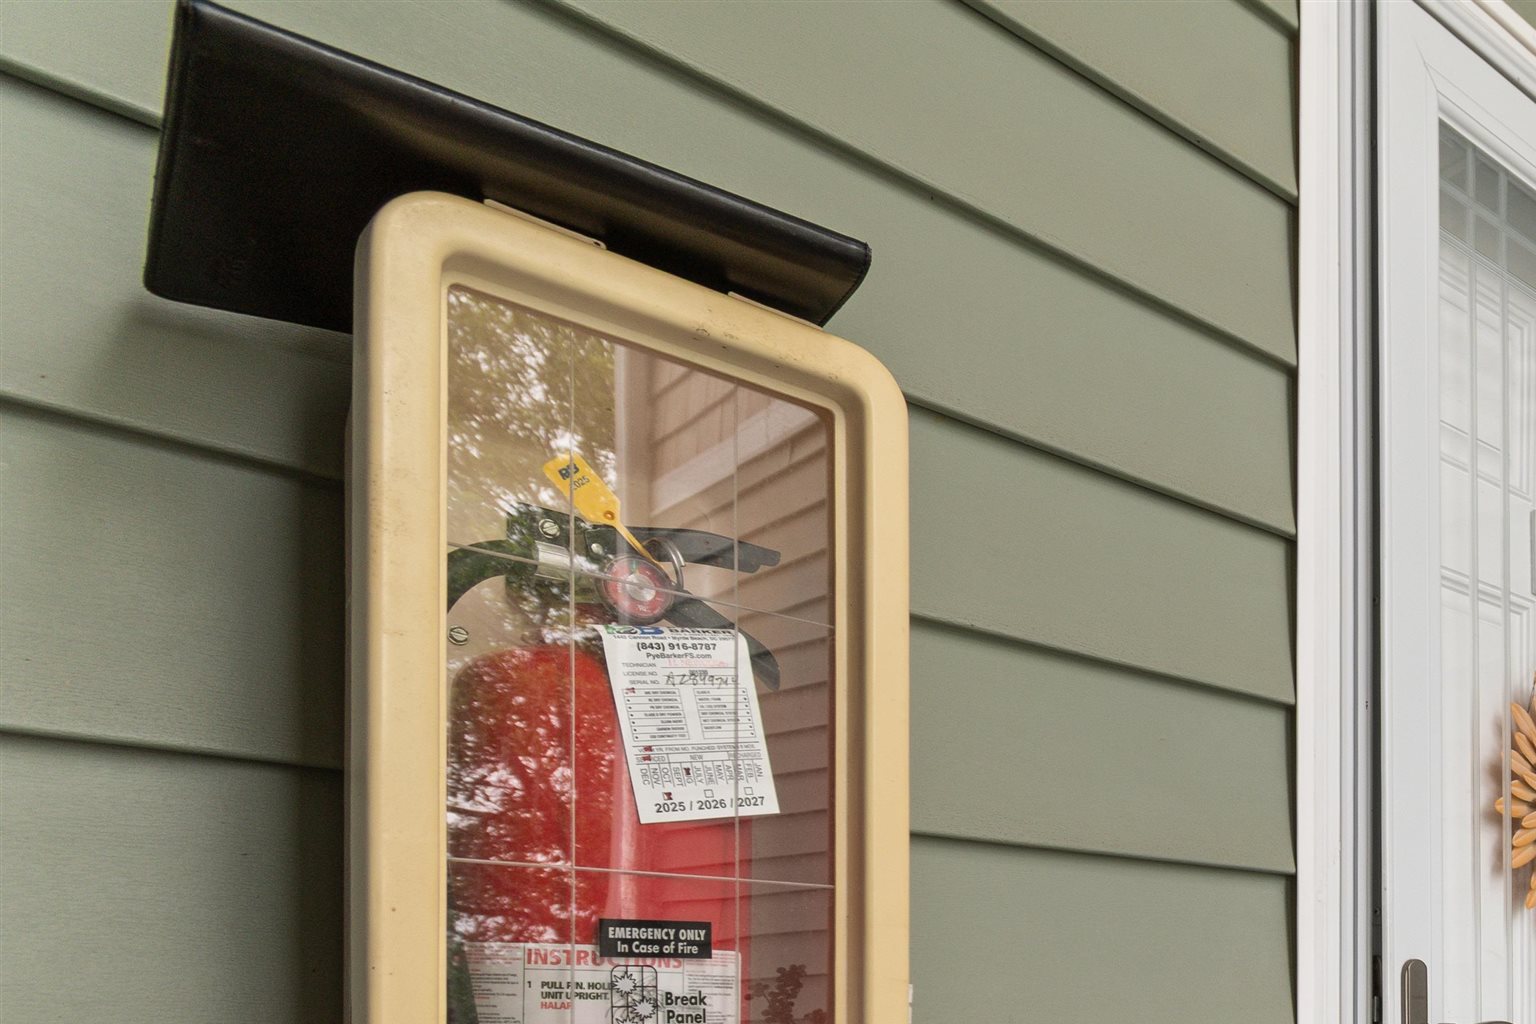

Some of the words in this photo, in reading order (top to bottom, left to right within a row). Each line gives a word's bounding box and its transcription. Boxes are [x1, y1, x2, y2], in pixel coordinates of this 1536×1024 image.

[637, 642, 665, 651] (843)
[668, 642, 717, 651] 916-8787
[646, 652, 712, 660] PyeBarkerFS.com
[640, 768, 650, 786] DEC
[651, 767, 661, 785] NOV
[662, 767, 672, 784] OCT
[673, 766, 683, 787] SEPT
[694, 765, 704, 784] JULY
[704, 765, 715, 785] JUNE
[715, 764, 725, 781] MAY
[725, 764, 735, 780] APR
[745, 763, 753, 778] FEB
[754, 762, 763, 778] JAN
[654, 801, 686, 813] 2025
[698, 799, 727, 810] 2026
[737, 796, 765, 807] 2027
[608, 926, 675, 941] EMERGENCY
[679, 929, 706, 941] ONLY
[617, 941, 629, 953] In
[636, 942, 660, 954] Case
[663, 942, 675, 954] of
[678, 943, 699, 954] Fire
[541, 981, 564, 990] PULL
[567, 981, 586, 990] PN.
[541, 991, 564, 1000] UNIT
[565, 991, 609, 1000] UPRIGHT.
[665, 990, 708, 1006] Break
[666, 1009, 707, 1024] Panel
